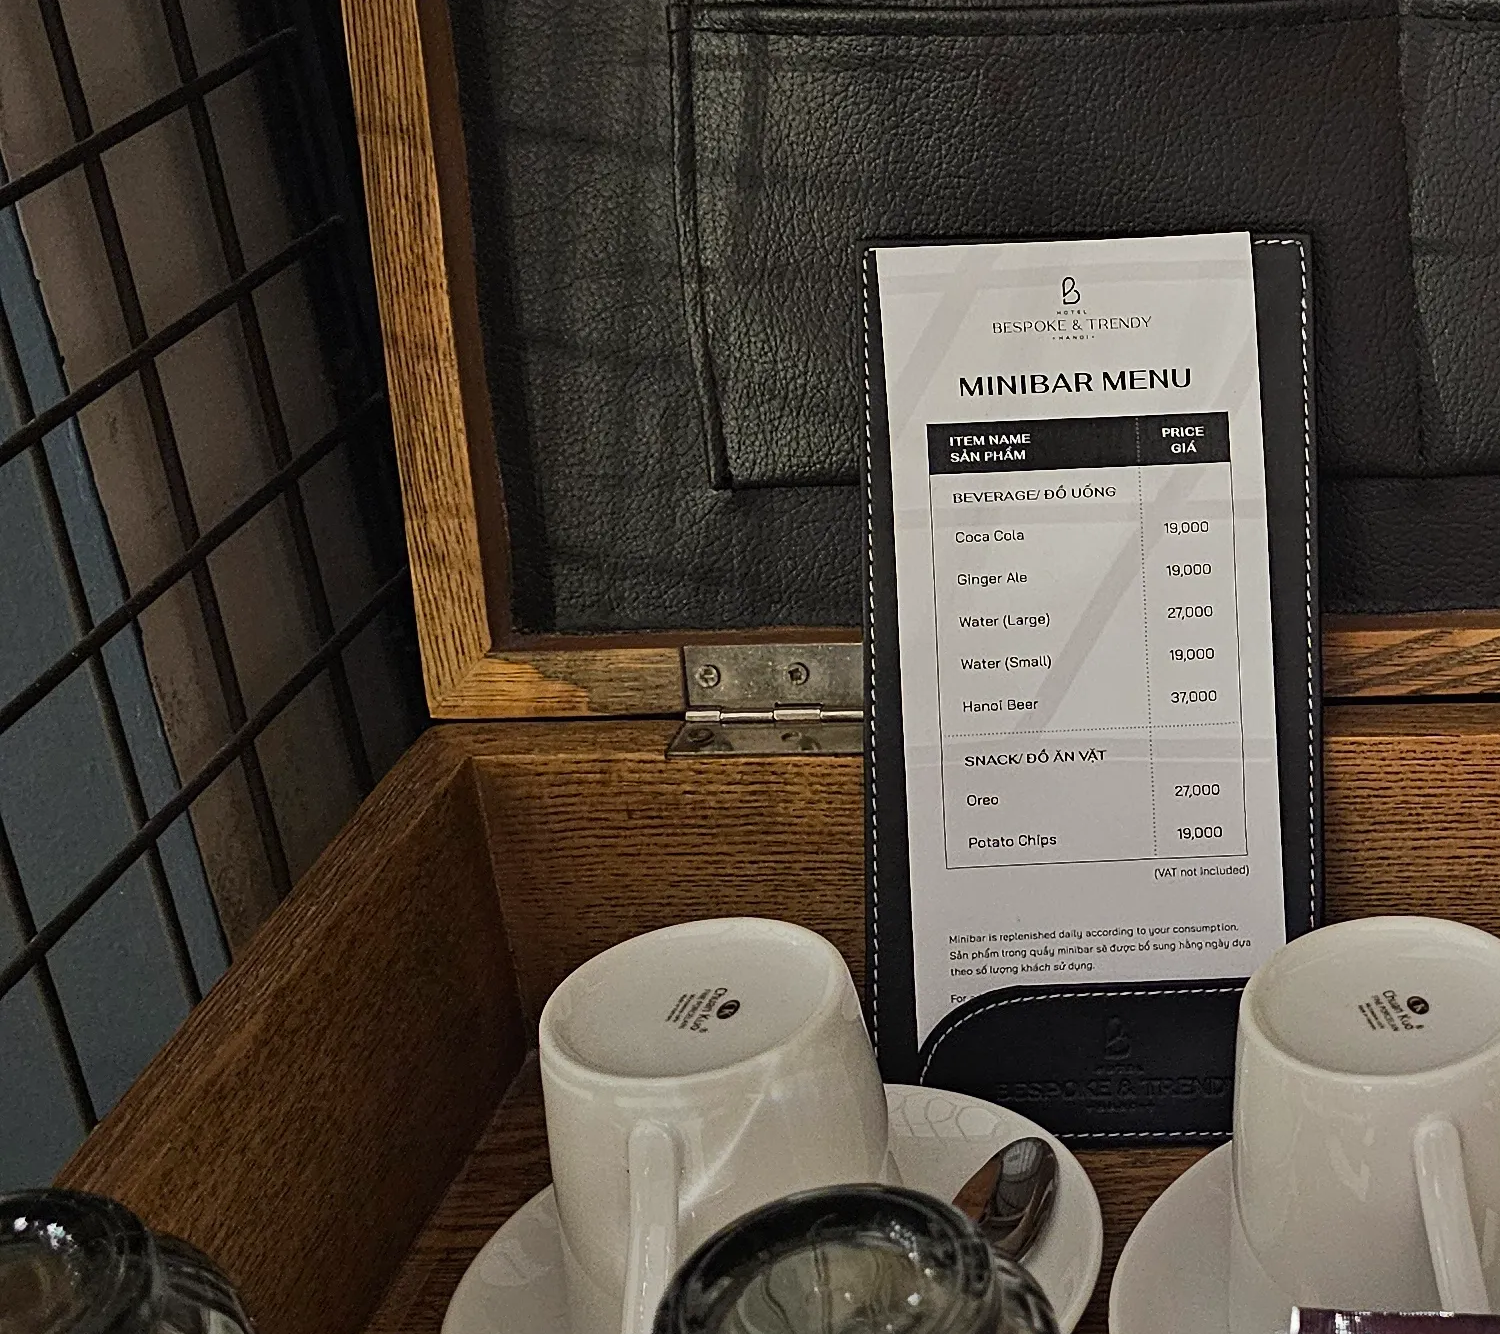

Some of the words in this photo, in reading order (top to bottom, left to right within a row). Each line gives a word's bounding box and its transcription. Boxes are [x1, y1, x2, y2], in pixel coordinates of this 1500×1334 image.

[993, 319, 1067, 334] BESPOKE
[1072, 319, 1083, 331] &
[1088, 315, 1152, 330] TRENDY
[959, 372, 1093, 397] MINIBAR
[1102, 368, 1192, 391] MENU
[949, 434, 984, 446] ITEM
[989, 433, 1030, 445] NAME
[1161, 426, 1204, 438] PRICE
[1170, 439, 1197, 454] GIÁ
[950, 447, 980, 463] SẢN
[985, 446, 1026, 461] PHẨM
[952, 489, 1040, 505] BEVERAGE/
[1071, 483, 1116, 499] UỐNG
[1164, 521, 1209, 535] 19,000
[955, 531, 989, 543] Coca
[995, 529, 1024, 542] Cola
[1166, 563, 1211, 577] 19,000
[957, 572, 1001, 587] Ginger
[1007, 571, 1028, 583] Ale
[1167, 605, 1213, 620] 27,000
[959, 615, 999, 628] Water
[1003, 613, 1050, 629] (Large)
[1169, 647, 1215, 662] 19,000
[961, 657, 1001, 670] Water
[1004, 655, 1052, 671] (Small)
[1171, 690, 1217, 704] 37,000
[962, 699, 1003, 712] Hanoi
[1007, 699, 1038, 711] Beer
[964, 754, 1023, 767] SNACK/
[1053, 747, 1075, 763] ĂN
[1079, 748, 1106, 764] VẶT
[1175, 783, 1220, 798] 27,000
[966, 793, 999, 807] Oreo
[1177, 826, 1223, 840] 19,000
[968, 835, 1014, 849] Potato
[1018, 833, 1057, 848] Chips
[1154, 867, 1177, 879] (VAT
[1181, 867, 1196, 877] not
[1200, 864, 1250, 877] included)
[949, 933, 986, 944] Minibar
[988, 933, 997, 942] is
[1000, 930, 1056, 943] replenished
[1059, 929, 1082, 941] daily
[1086, 927, 1133, 939] according
[1137, 926, 1146, 935] to
[1149, 926, 1170, 938] your
[1001, 947, 1026, 959] trong
[1058, 944, 1093, 955] minibar
[1153, 940, 1176, 952] sung
[950, 967, 973, 977] theo
[1021, 961, 1051, 973] khách
[950, 994, 966, 1003] For
